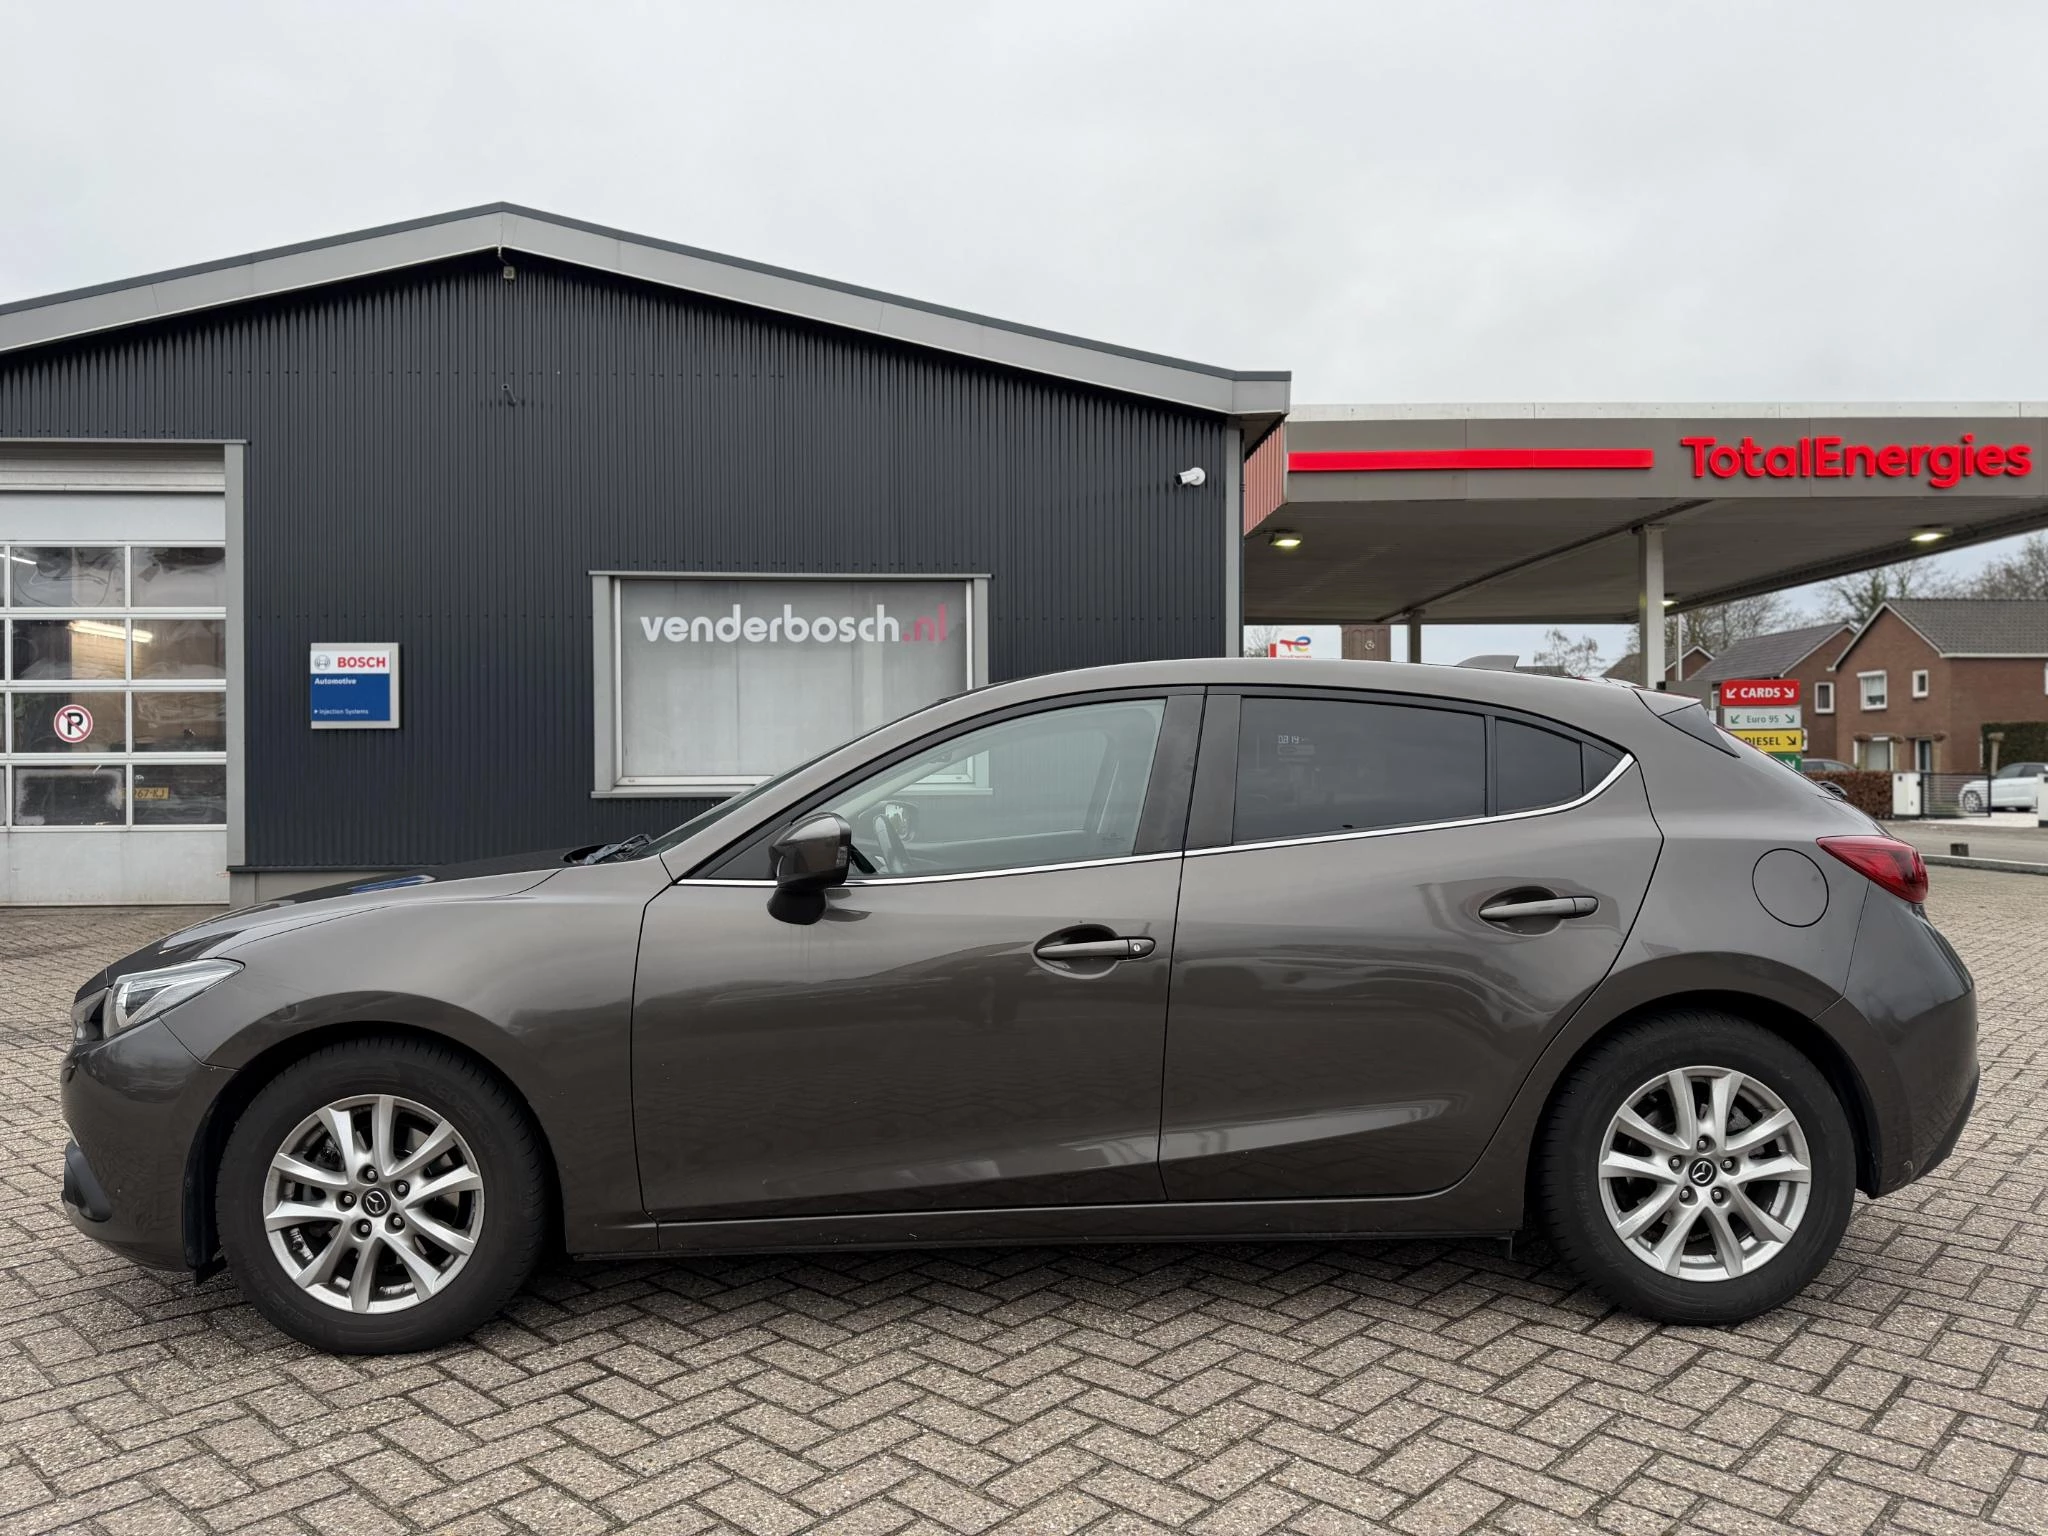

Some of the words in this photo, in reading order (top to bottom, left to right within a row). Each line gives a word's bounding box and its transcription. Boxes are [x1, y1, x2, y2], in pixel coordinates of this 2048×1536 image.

[1681, 433, 2033, 489] TotalEnergies
[639, 604, 948, 643] venderbosch.nl
[337, 656, 386, 668] BOSCH
[314, 677, 357, 685] Automotive
[1740, 687, 1781, 698] CARDS
[345, 708, 369, 716] Systems
[1746, 715, 1766, 723] Euro
[1768, 715, 1780, 723] 95
